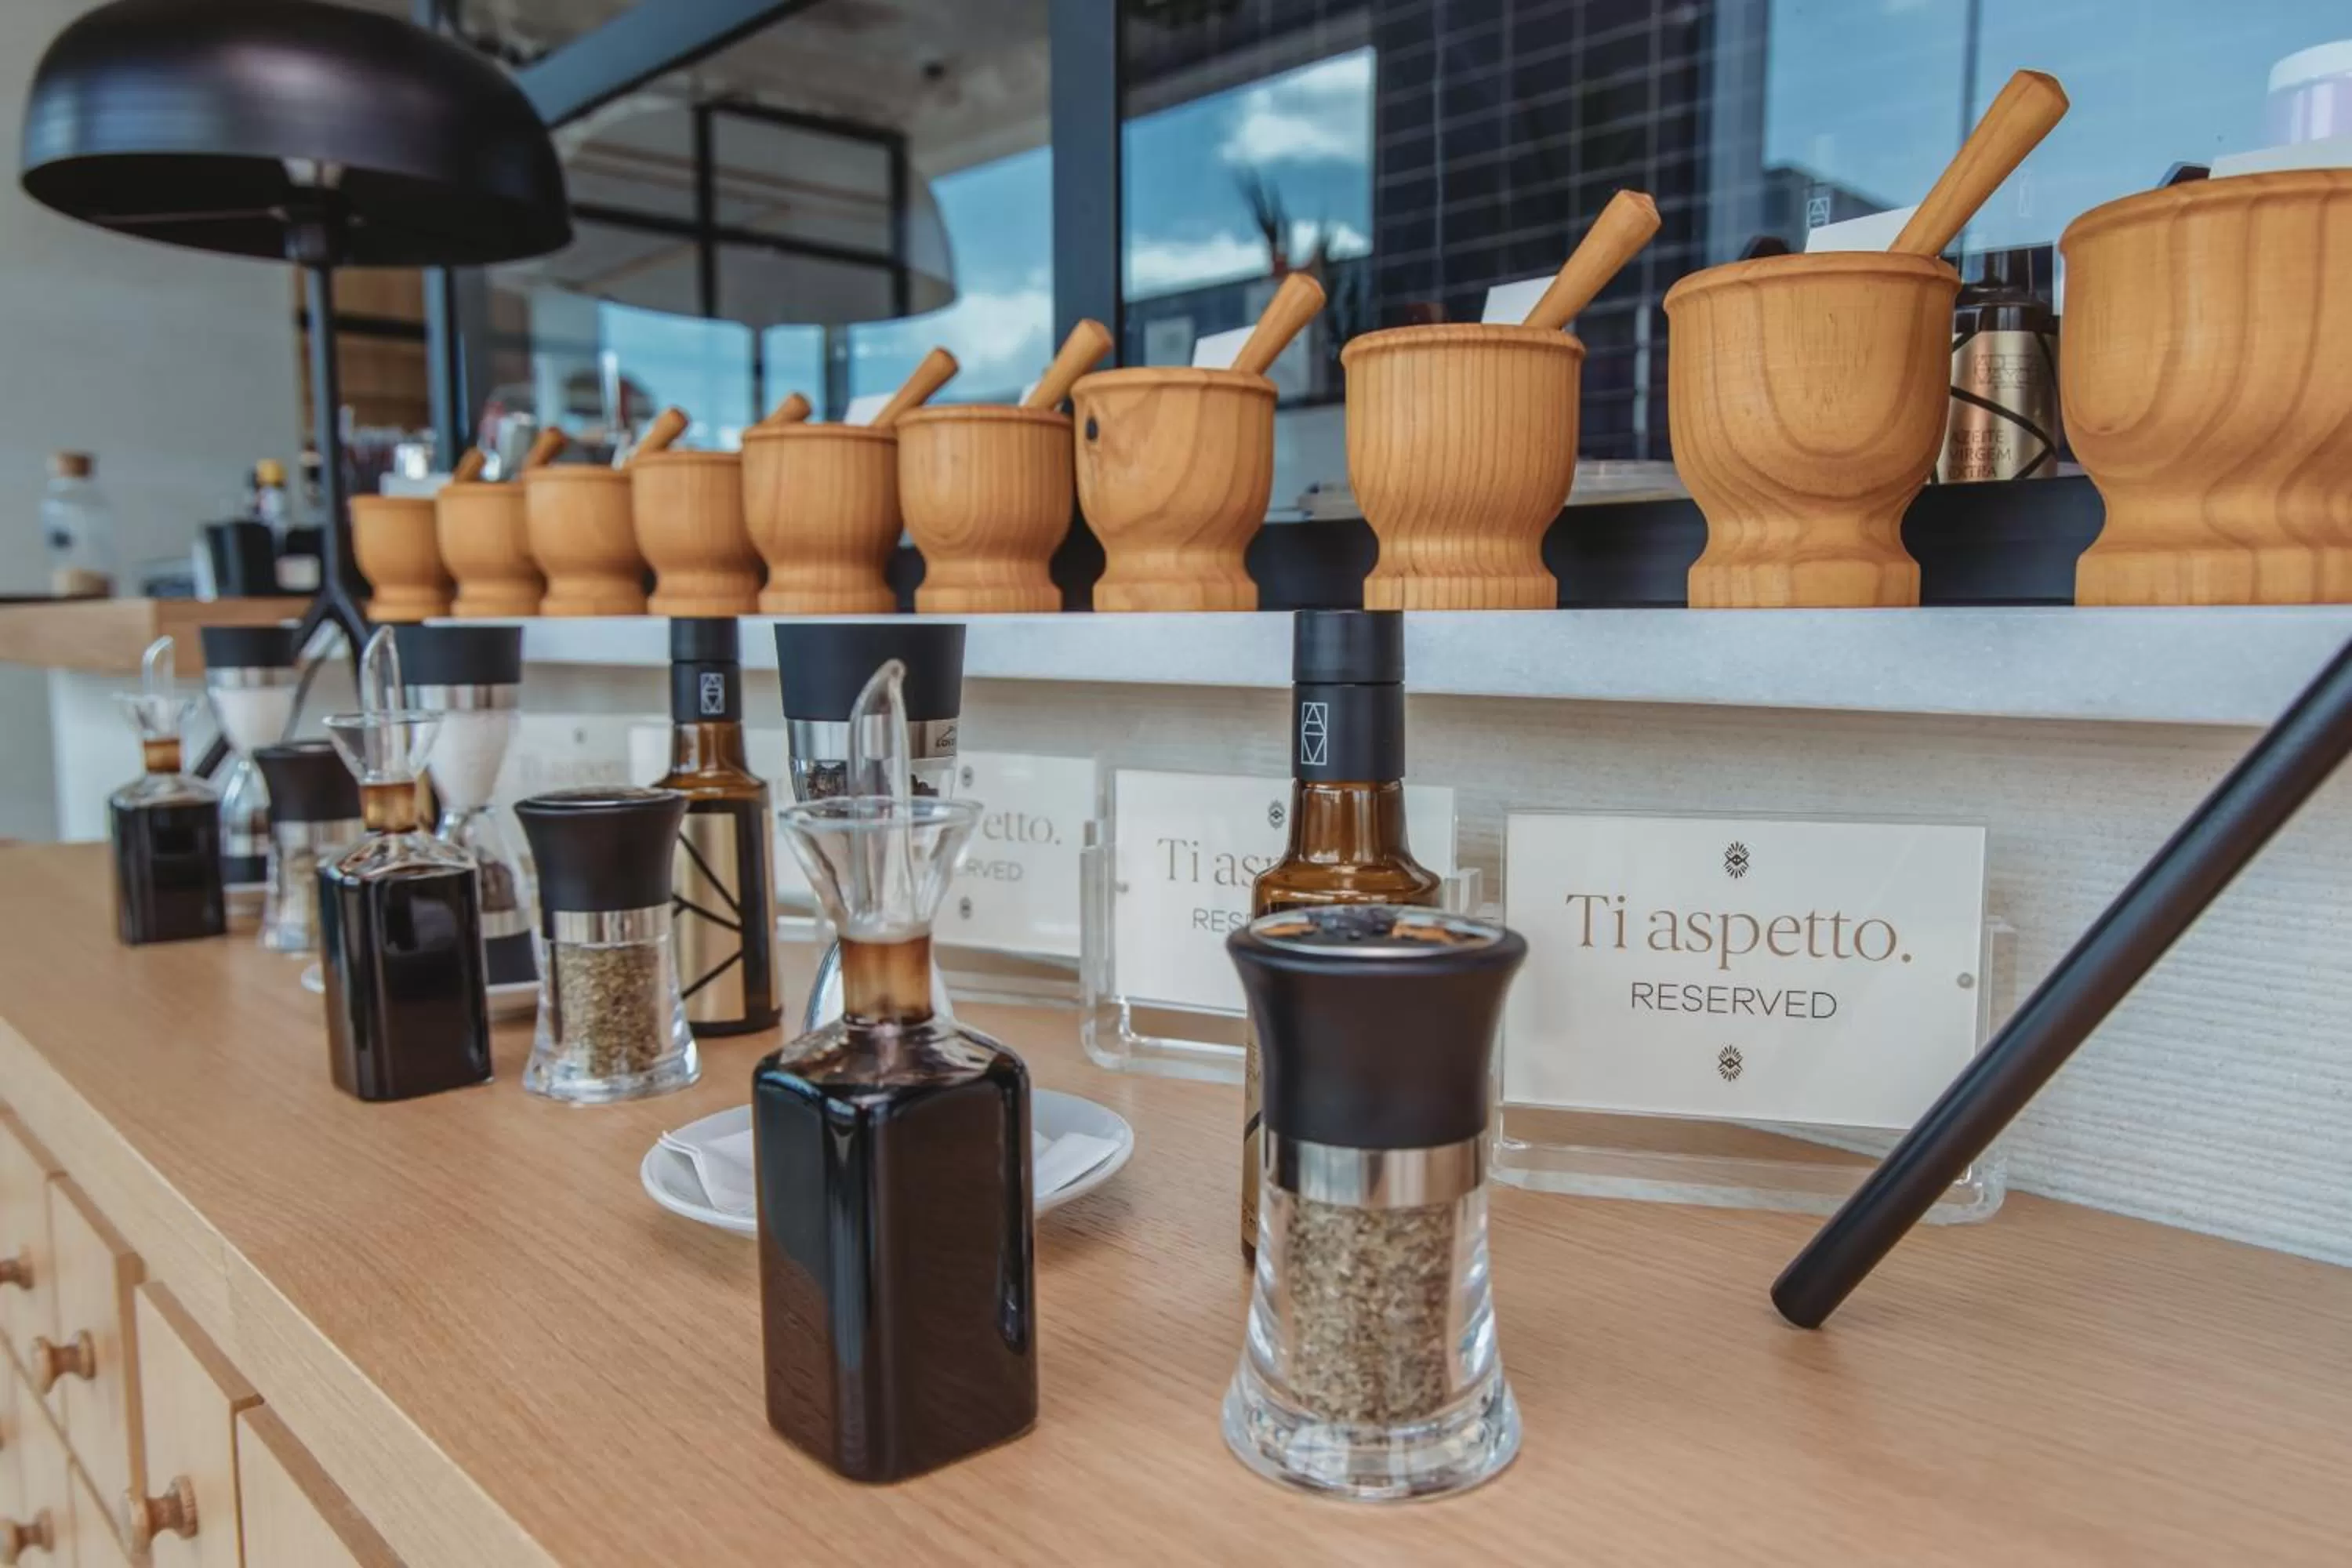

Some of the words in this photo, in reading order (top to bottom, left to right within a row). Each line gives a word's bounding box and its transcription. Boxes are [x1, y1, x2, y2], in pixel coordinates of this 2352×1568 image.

[1157, 837, 1199, 883] Ti
[1214, 852, 1281, 888] as
[1566, 894, 1628, 949] Ti
[1646, 909, 1913, 970] aspetto.
[1631, 982, 1837, 1019] RESERVED
